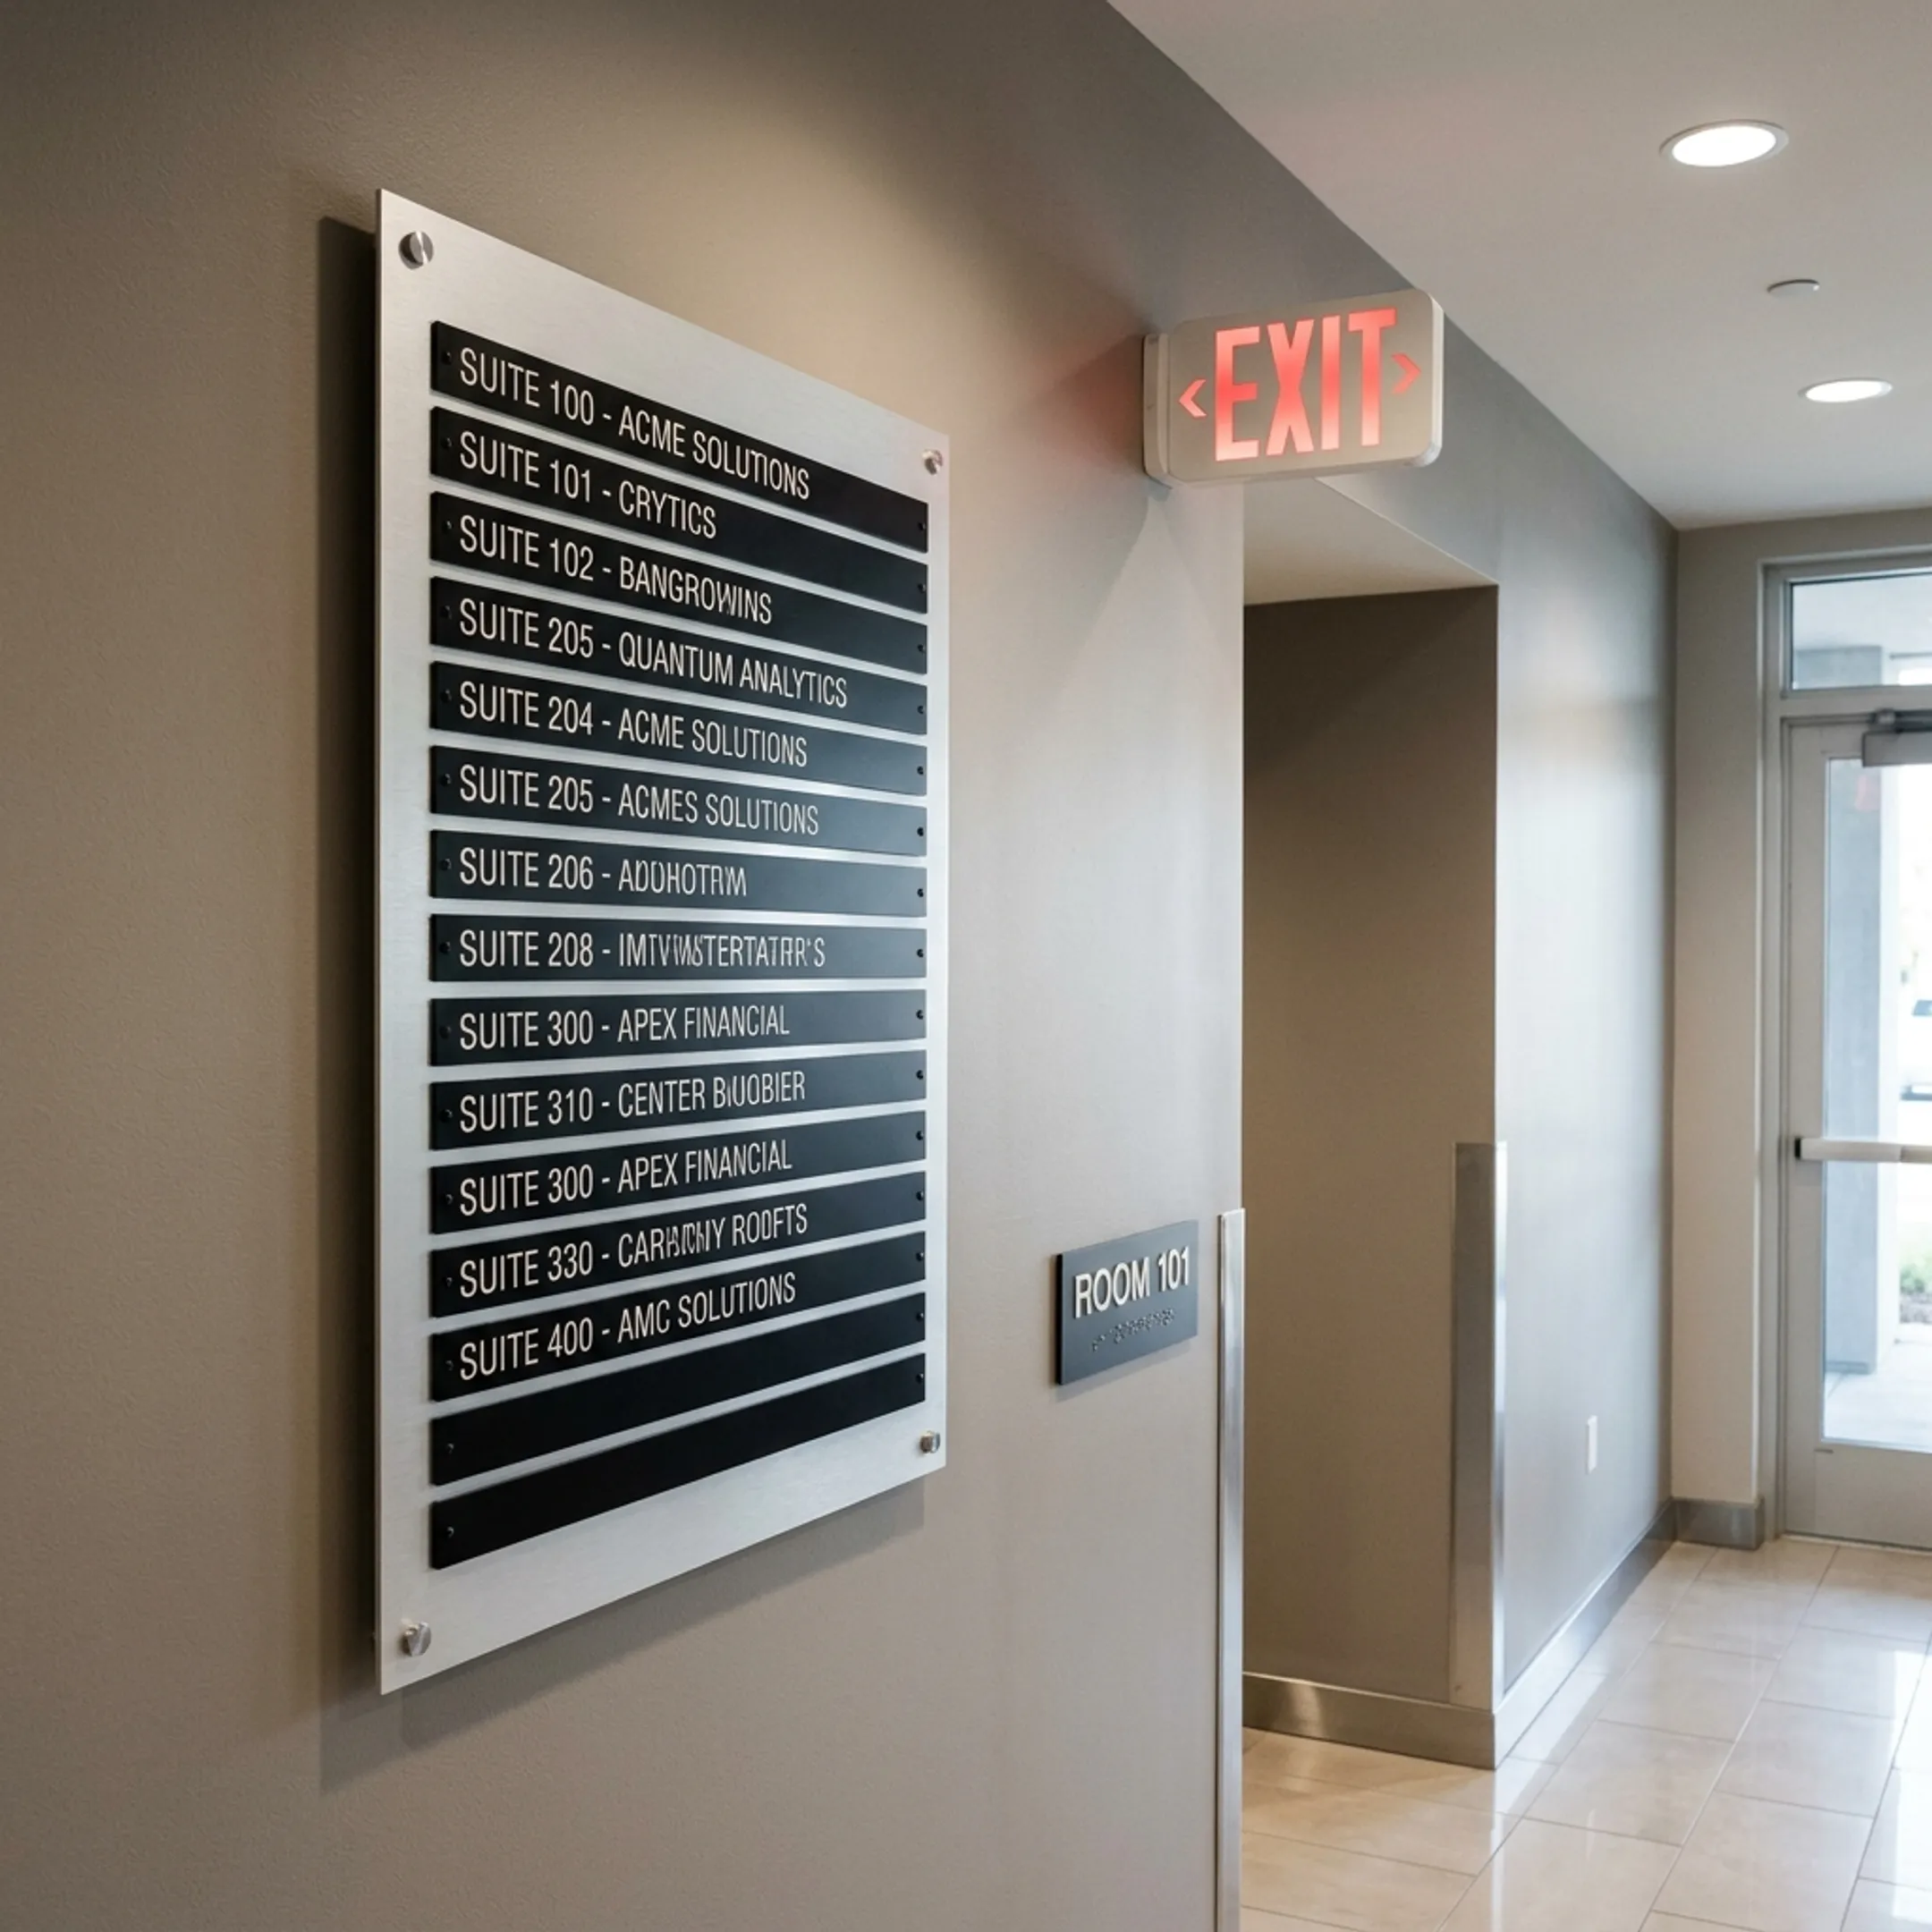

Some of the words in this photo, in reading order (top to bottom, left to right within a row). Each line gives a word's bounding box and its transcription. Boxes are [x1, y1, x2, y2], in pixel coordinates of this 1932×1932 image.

[1215, 306, 1397, 462] EXIT
[460, 346, 541, 408] SUITE
[549, 379, 595, 427] 100
[602, 412, 613, 421] -
[618, 404, 687, 458] ACME
[691, 429, 810, 499] SOLUTIONS
[460, 429, 541, 488] SUITE
[548, 459, 590, 504] 101
[601, 488, 612, 497] -
[618, 479, 717, 538] CRYTICS
[459, 514, 540, 569] SUITE
[548, 537, 594, 582] 102
[601, 566, 613, 574] -
[459, 597, 540, 648] SUITE
[547, 616, 594, 658] 205
[601, 642, 612, 650] -
[618, 631, 733, 687] QUANTUM
[739, 657, 848, 709] ANALYTICS
[459, 680, 540, 728] SUITE
[547, 695, 594, 736] 204
[617, 707, 685, 750] ACME
[691, 718, 808, 767] SOLUTIONS
[459, 763, 540, 809] SUITE
[547, 774, 594, 814] 205
[617, 783, 699, 824] ACMES
[705, 792, 819, 835] SOLUTIONS
[459, 846, 540, 888] SUITE
[547, 852, 594, 891] 206
[459, 928, 540, 968] SUITE
[547, 931, 594, 968] 208
[459, 1011, 540, 1051] SUITE
[547, 1009, 594, 1047] 300
[616, 1006, 678, 1043] APEX
[683, 1004, 791, 1039] FINANCIAL
[459, 1089, 539, 1134] SUITE
[547, 1086, 594, 1126] 310
[618, 1077, 706, 1119] CENTER
[459, 1169, 540, 1216] SUITE
[547, 1163, 594, 1204] 300
[601, 1176, 611, 1184] -
[616, 1152, 679, 1194] APEX
[684, 1139, 793, 1184] FINANCIAL
[459, 1248, 539, 1299] SUITE
[547, 1240, 594, 1283] 330
[601, 1252, 611, 1260] -
[1074, 1256, 1150, 1318] ROOM
[1157, 1245, 1191, 1292] 101
[460, 1327, 539, 1381] SUITE
[547, 1317, 594, 1359] 400
[601, 1327, 611, 1335] -
[616, 1299, 671, 1344] AMC
[676, 1271, 796, 1328] SOLUTIONS
